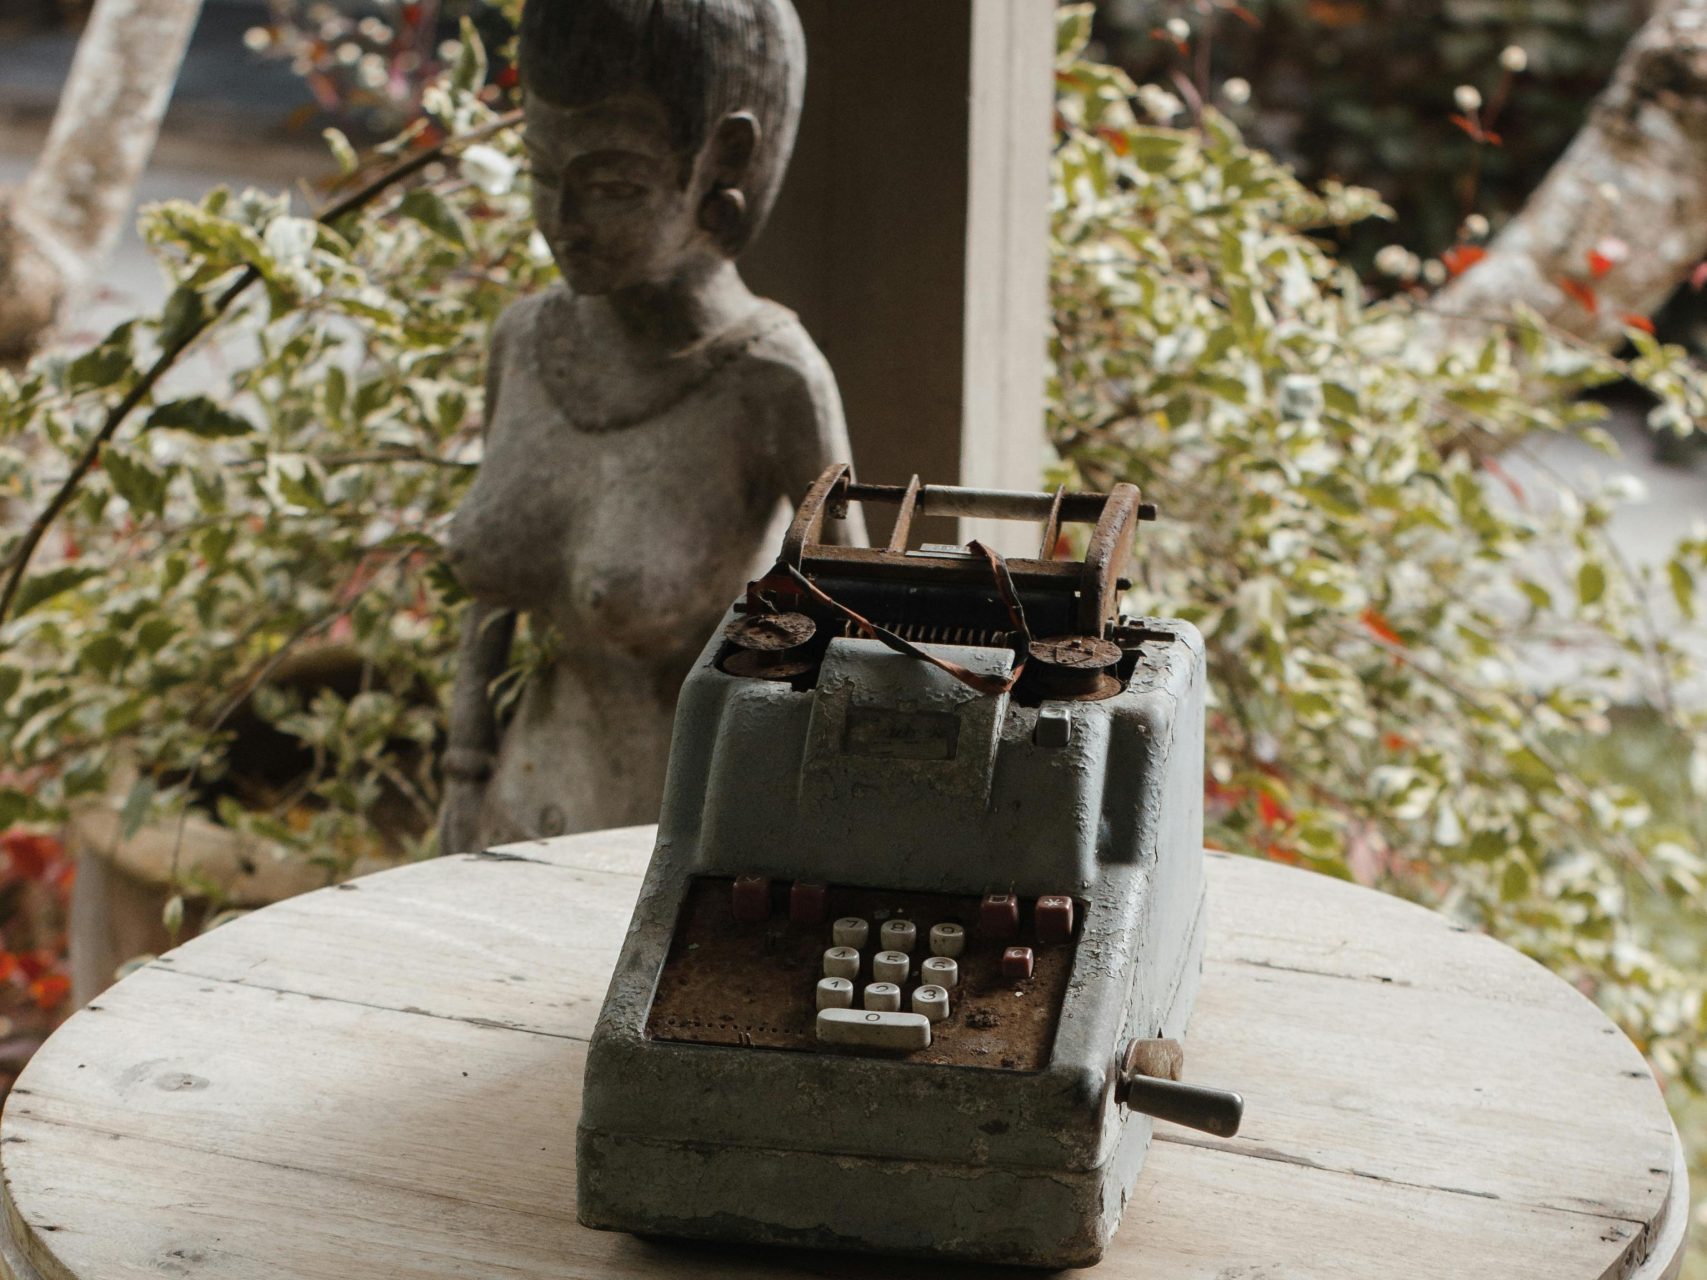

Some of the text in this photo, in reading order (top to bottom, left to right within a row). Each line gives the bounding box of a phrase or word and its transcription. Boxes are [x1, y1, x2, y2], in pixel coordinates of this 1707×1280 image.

[846, 919, 858, 928] 7
[890, 922, 906, 931] 8
[876, 985, 889, 993] 2
[923, 989, 937, 1000] 3
[865, 1013, 880, 1022] 0
